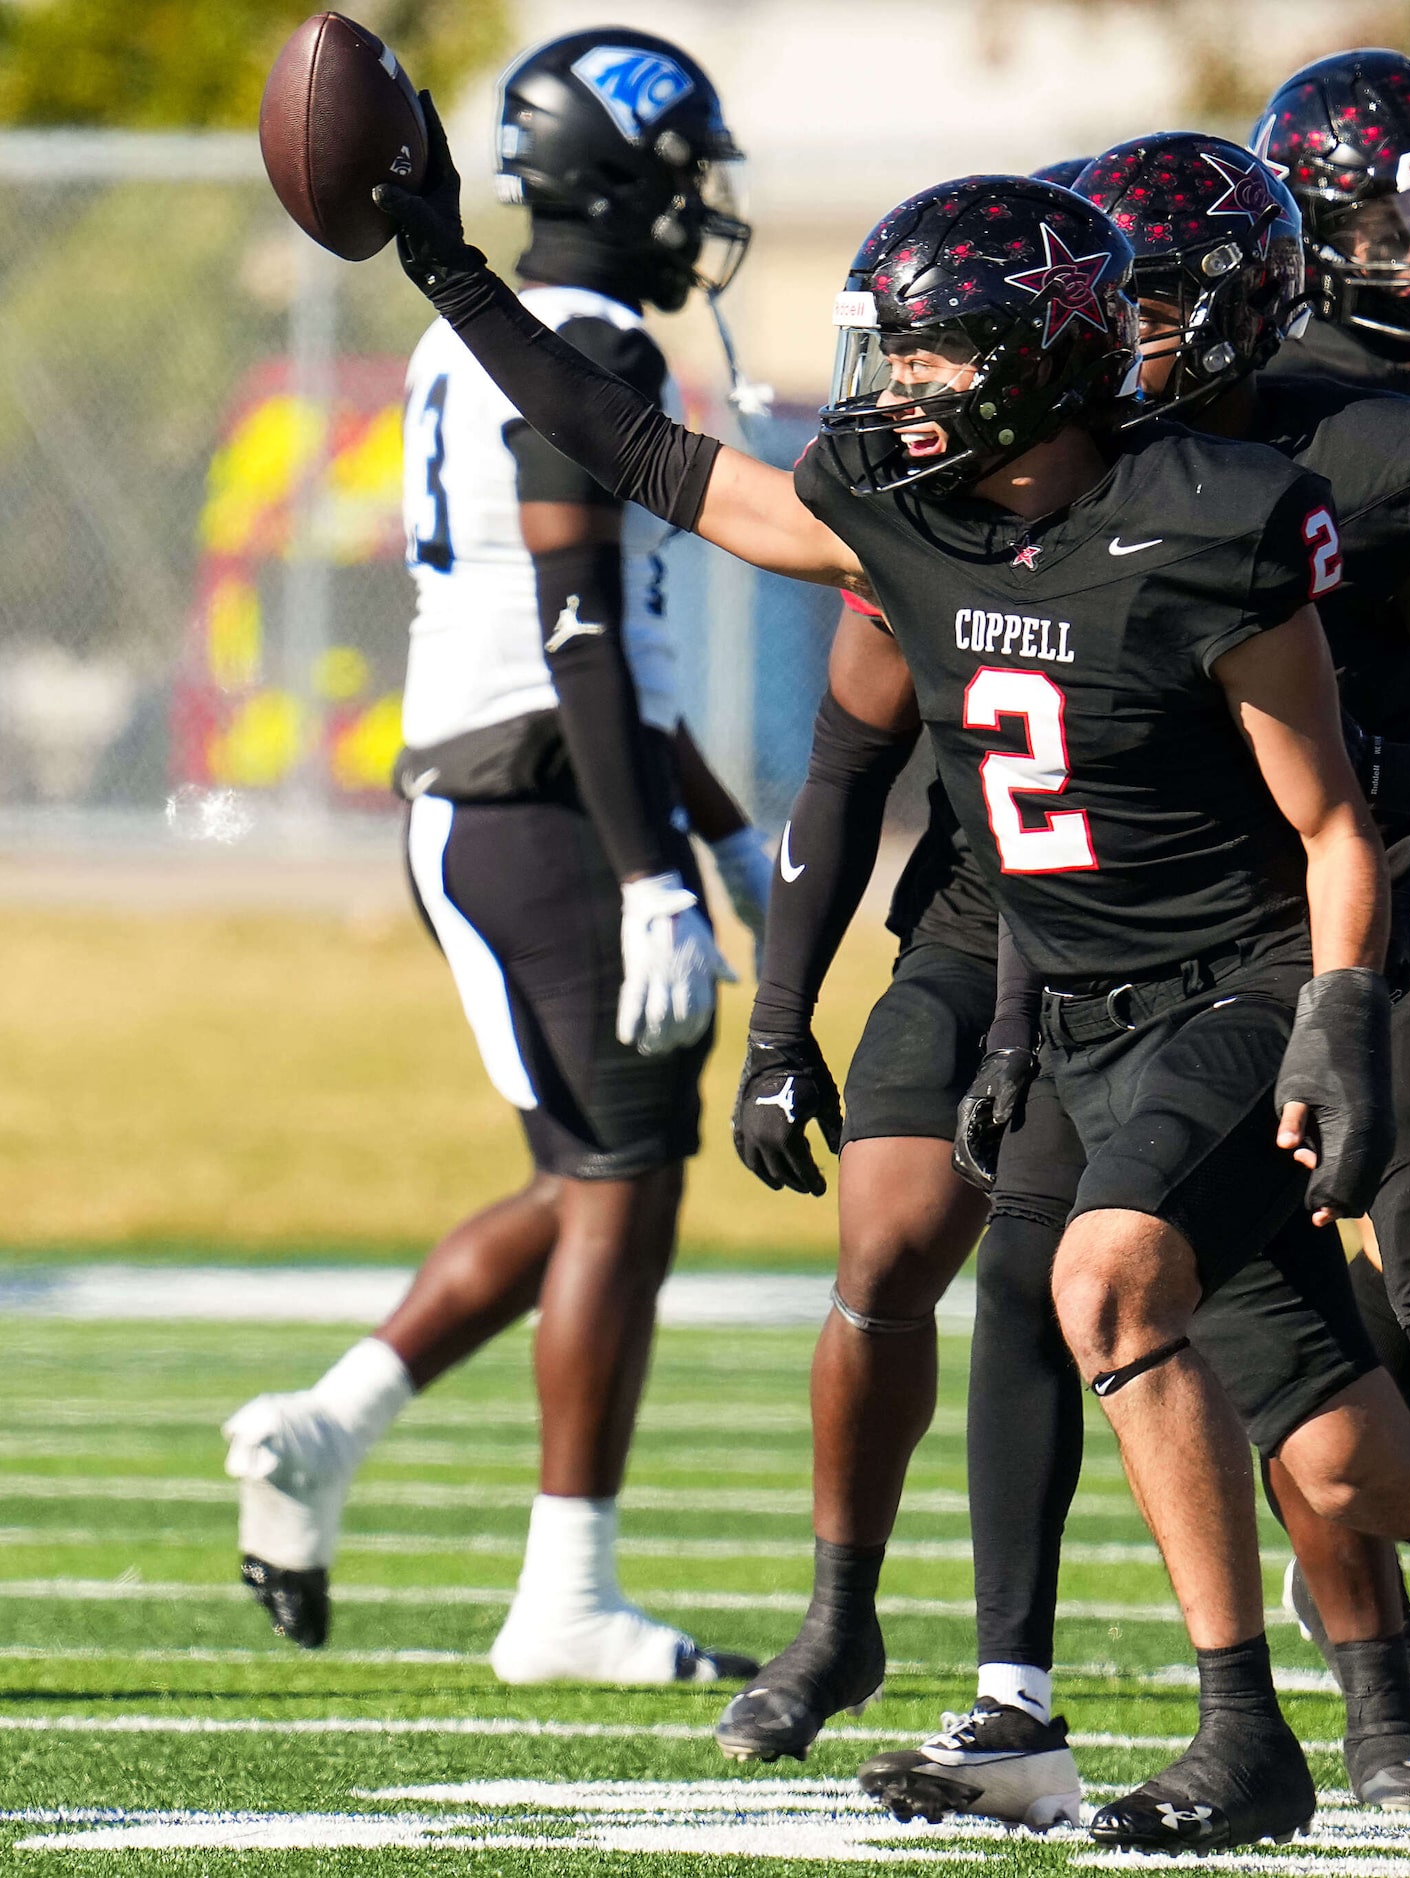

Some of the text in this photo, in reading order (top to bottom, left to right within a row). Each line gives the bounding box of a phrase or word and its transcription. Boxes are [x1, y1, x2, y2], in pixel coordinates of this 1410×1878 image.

[1301, 503, 1343, 601] 2
[955, 608, 1075, 663] COPPELL
[962, 664, 1100, 875] 2
